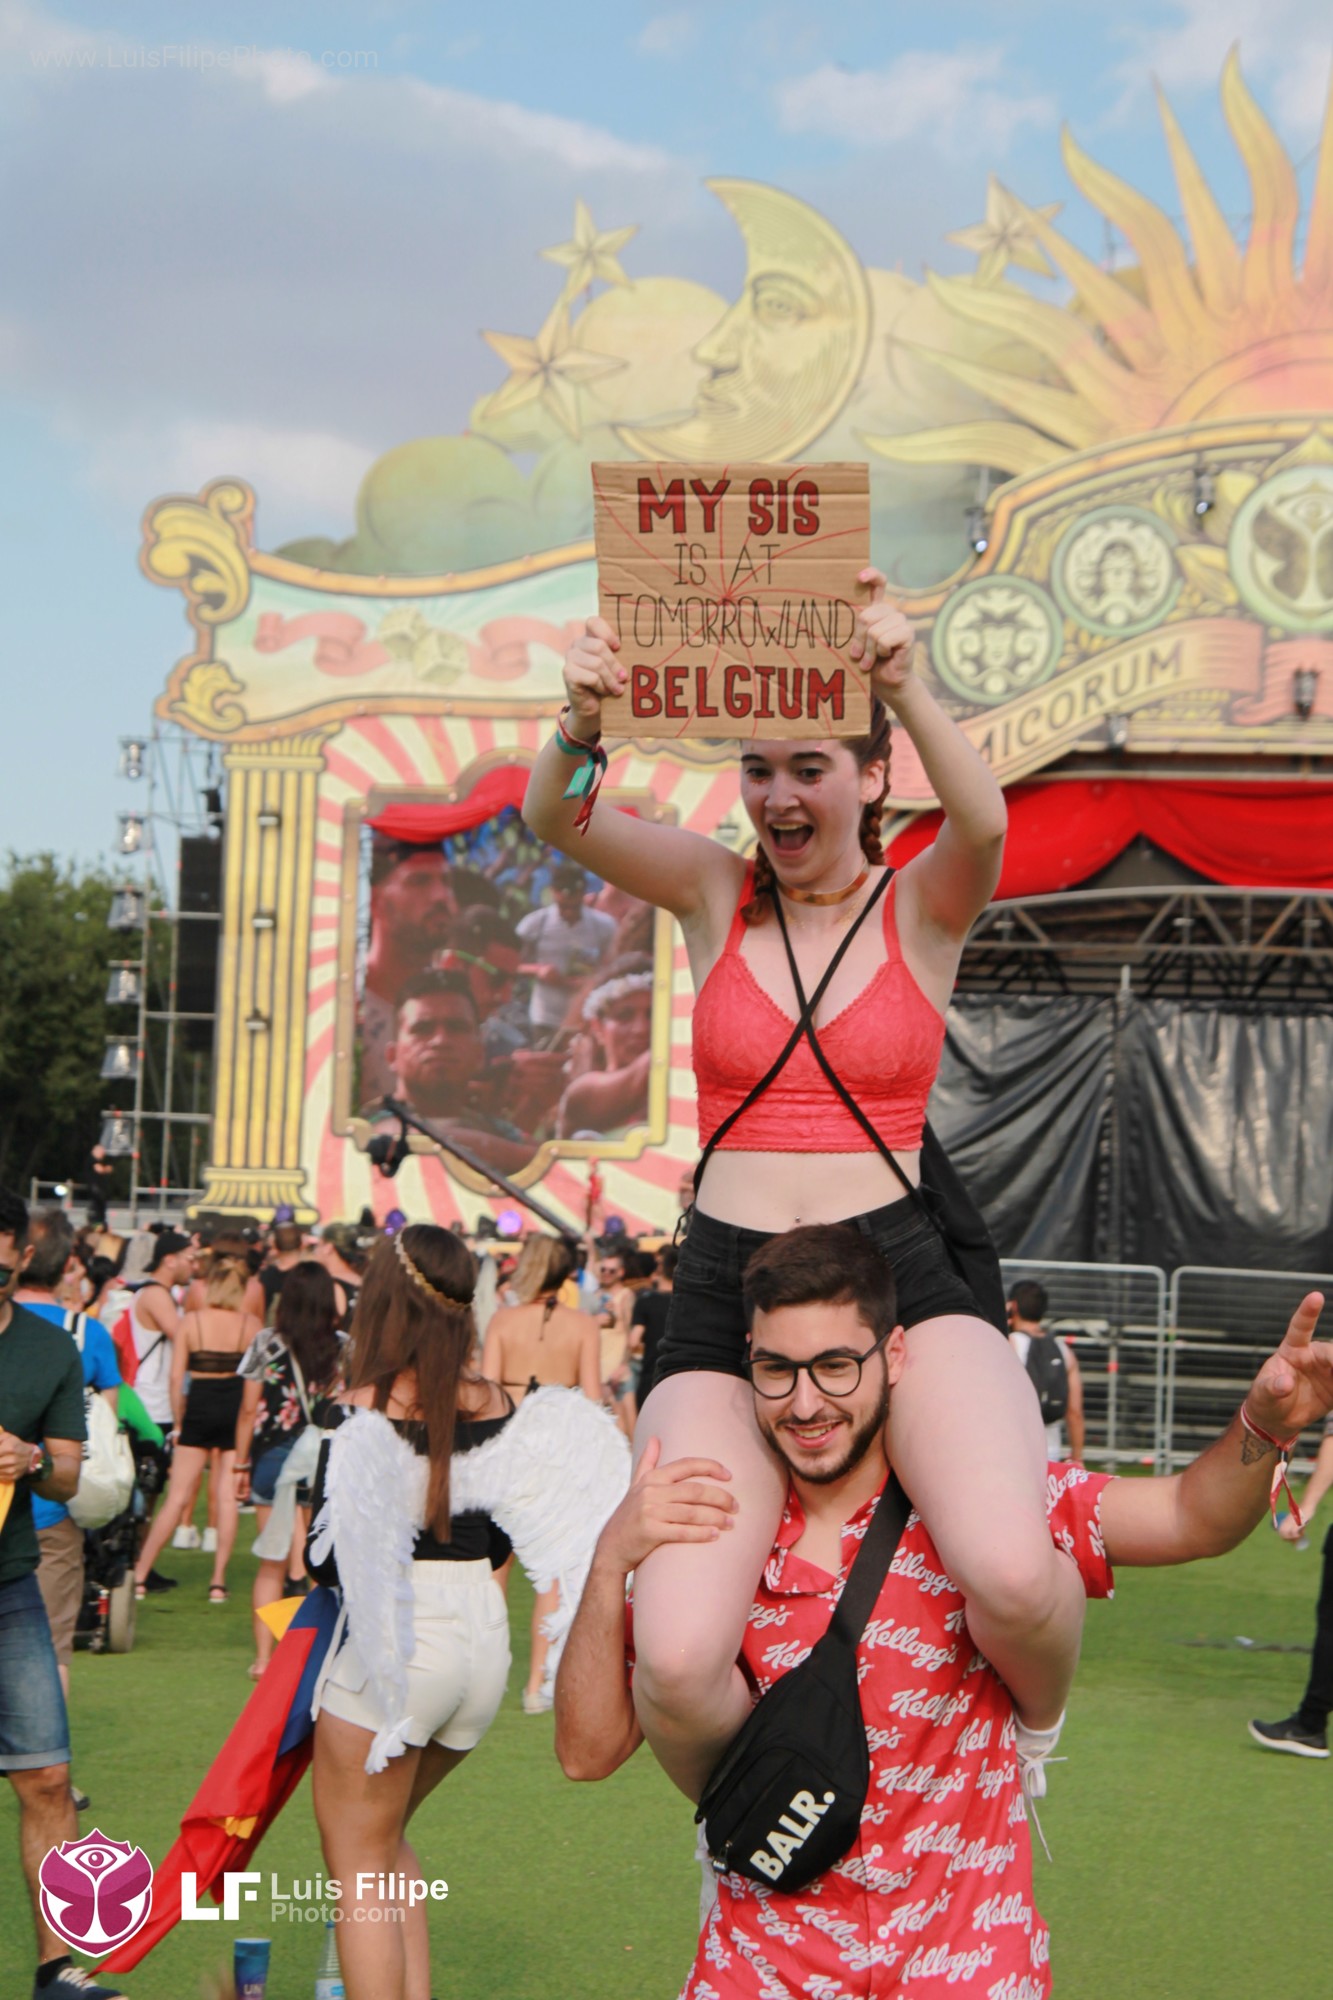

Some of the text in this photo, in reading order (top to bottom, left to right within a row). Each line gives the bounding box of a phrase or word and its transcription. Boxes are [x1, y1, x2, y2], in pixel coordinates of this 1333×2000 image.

[637, 477, 819, 536] MY SIS
[674, 543, 780, 585] IS AT
[631, 664, 845, 720] BELGIUM
[859, 1618, 960, 1672] Kellogg's
[749, 1790, 836, 1881] BALR.
